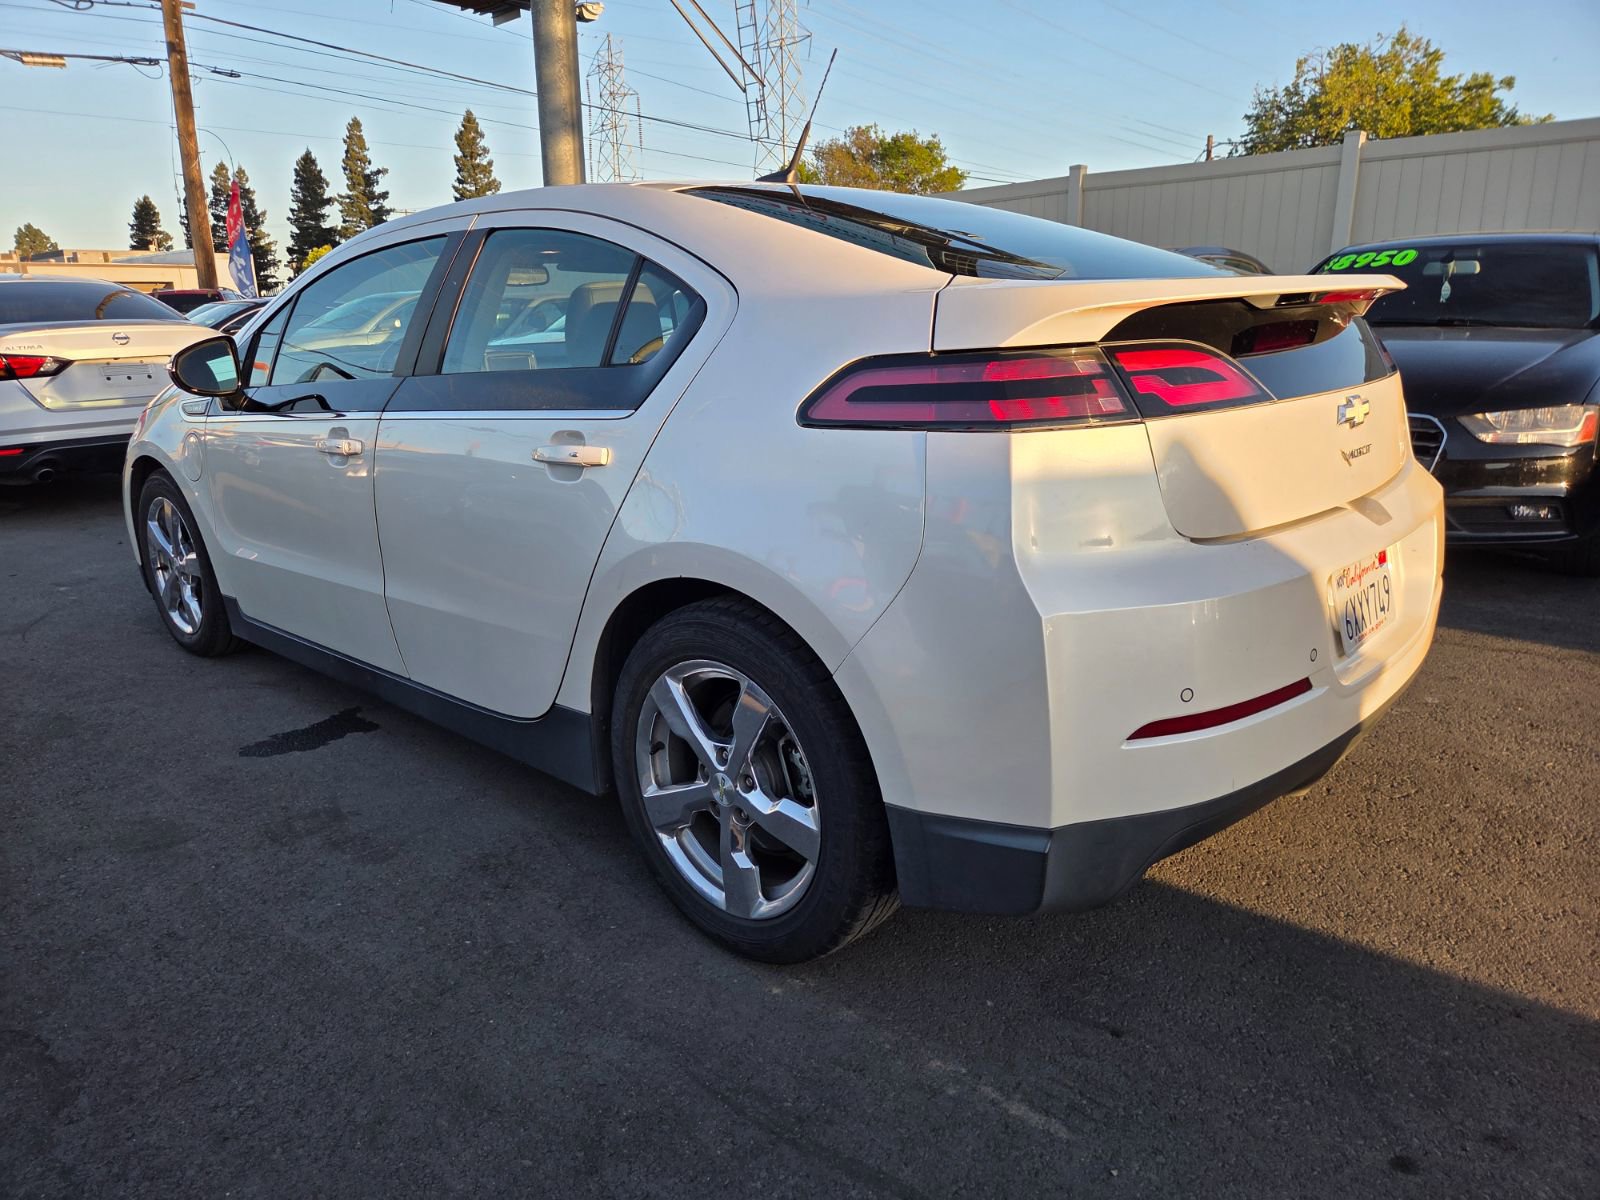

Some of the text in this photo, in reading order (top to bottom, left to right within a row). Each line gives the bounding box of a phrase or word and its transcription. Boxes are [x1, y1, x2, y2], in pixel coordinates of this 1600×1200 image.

[1324, 248, 1419, 271] $8950
[1344, 560, 1380, 588] California
[1345, 574, 1390, 640] 6XXY749
